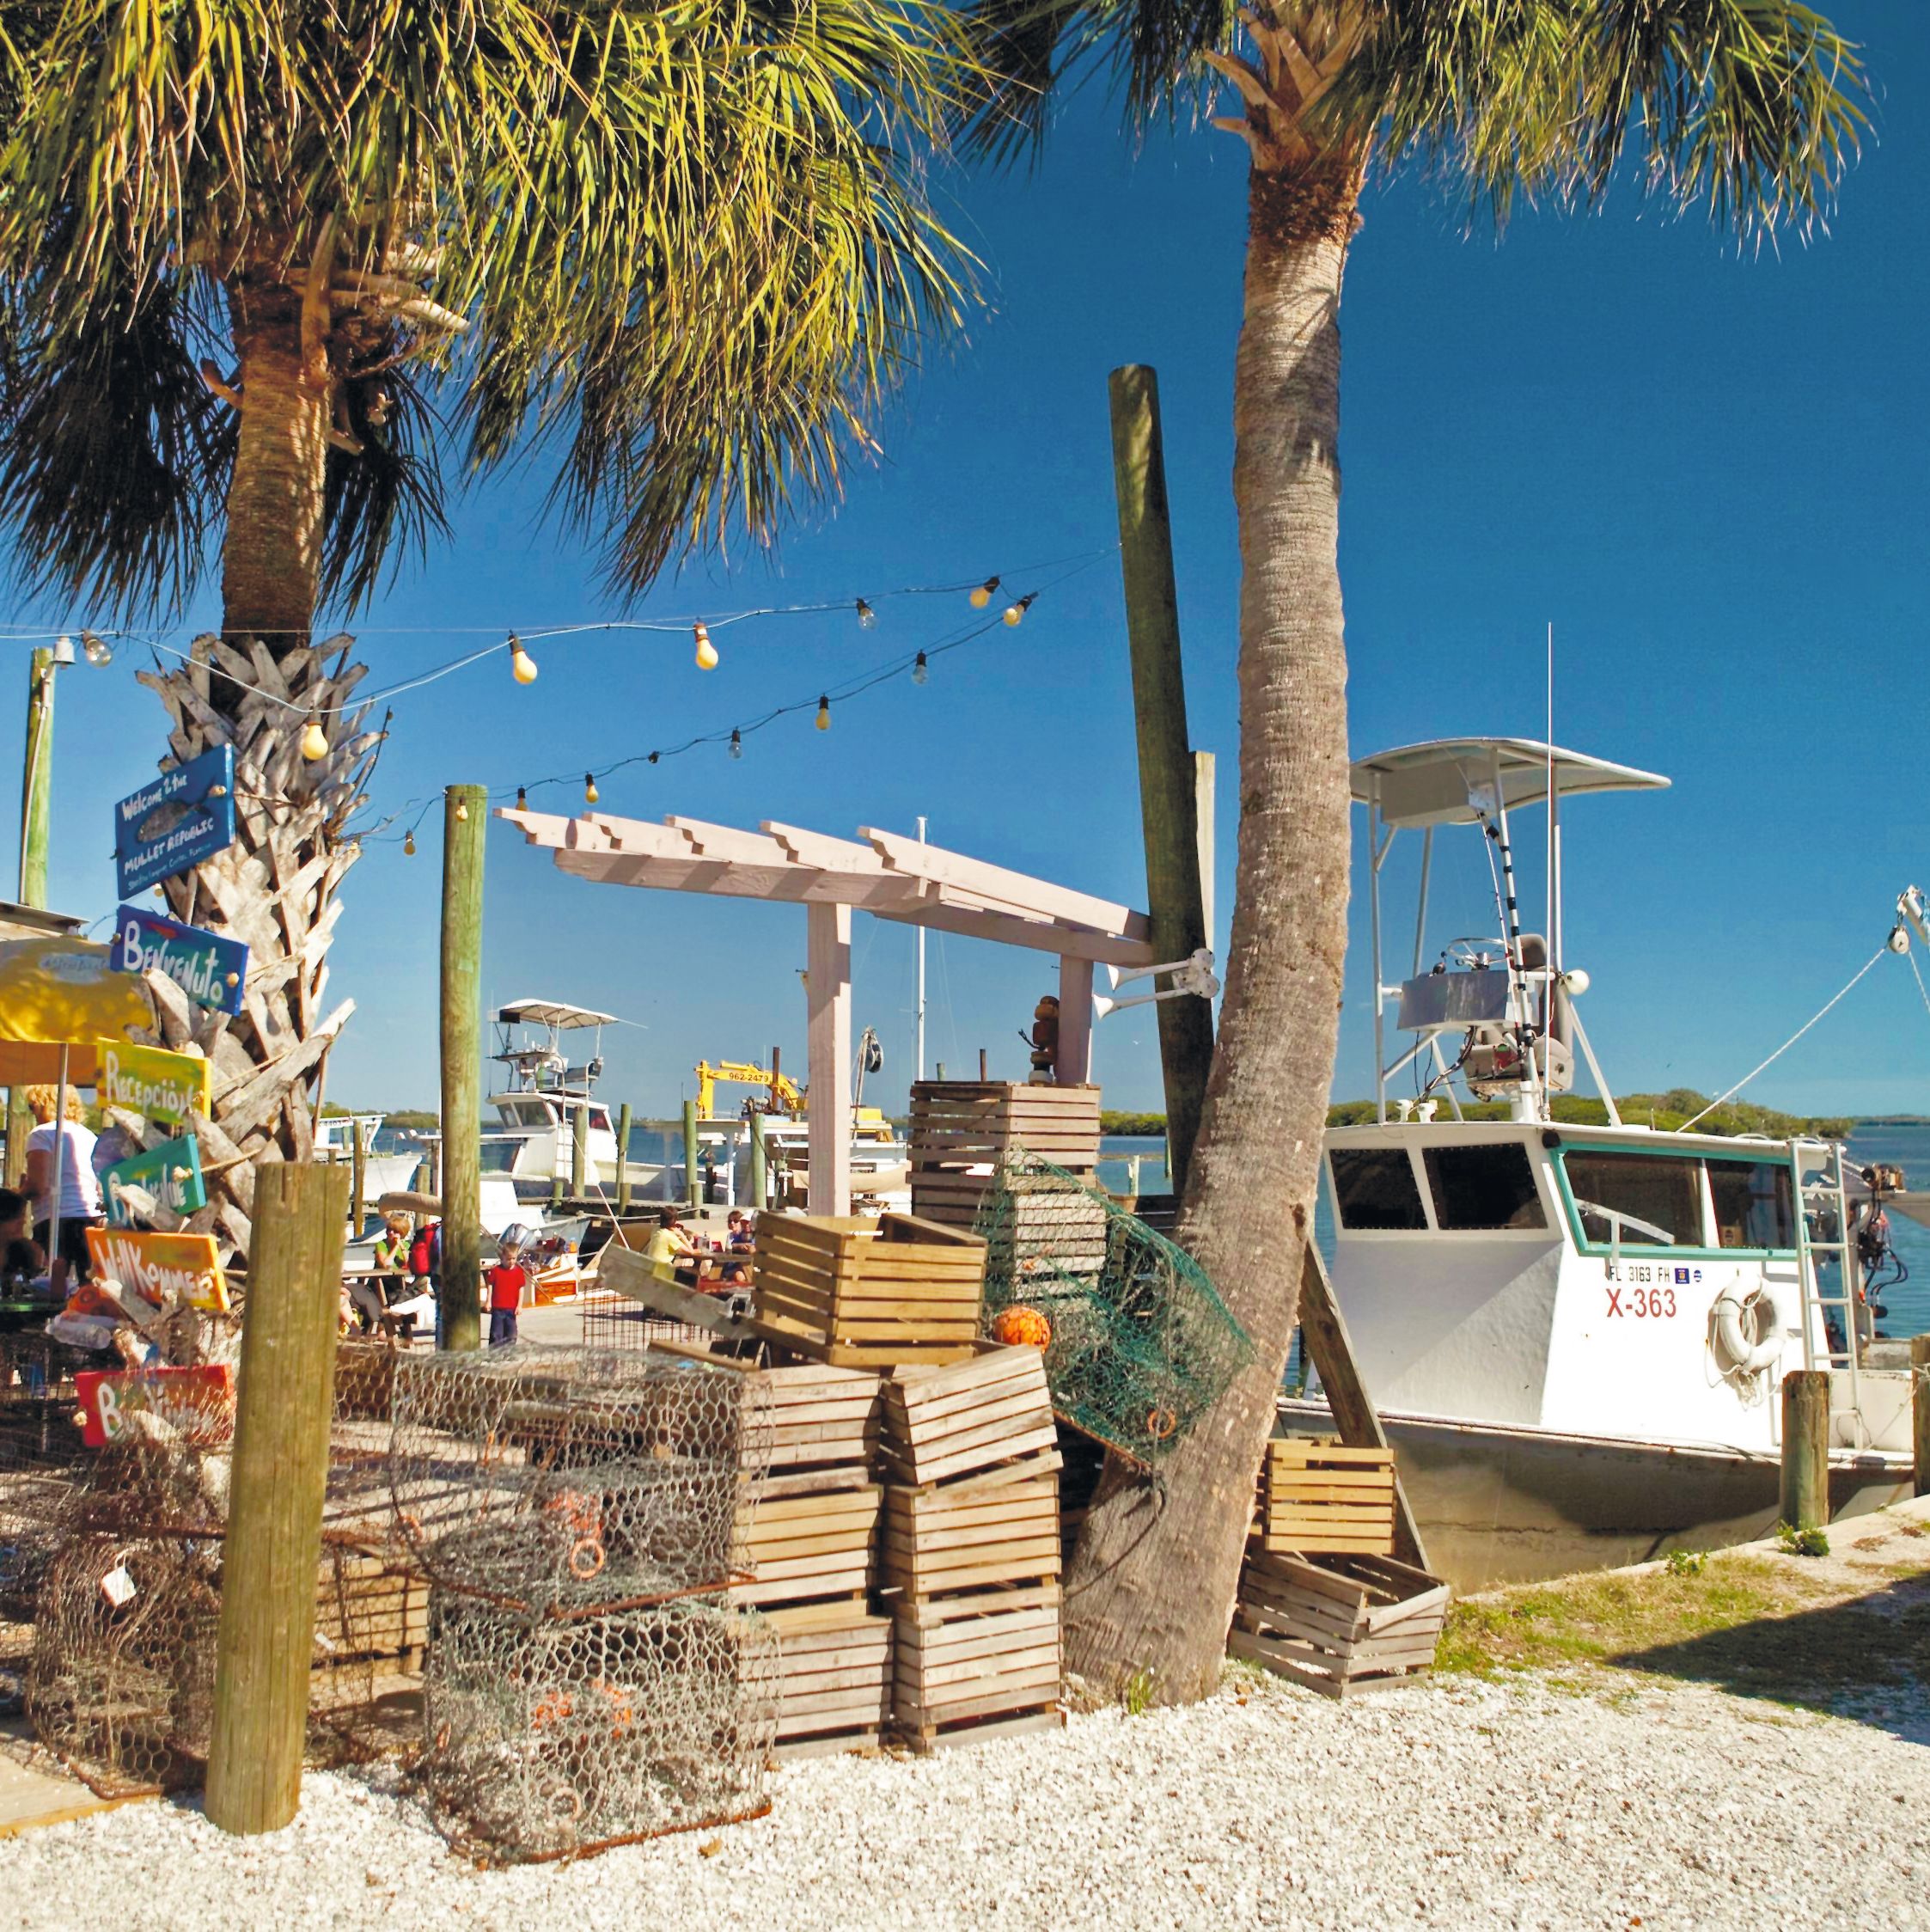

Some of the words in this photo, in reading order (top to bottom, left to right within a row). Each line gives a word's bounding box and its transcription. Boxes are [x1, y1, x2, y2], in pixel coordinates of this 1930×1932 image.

[125, 841, 165, 875] MULLET
[167, 817, 214, 851] REPUBLIC
[729, 1073, 769, 1083] 962-2479
[1609, 1265, 1622, 1281] FL
[1629, 1266, 1651, 1281] 3163
[1658, 1267, 1670, 1282] FH
[1605, 1288, 1677, 1318] X-363
